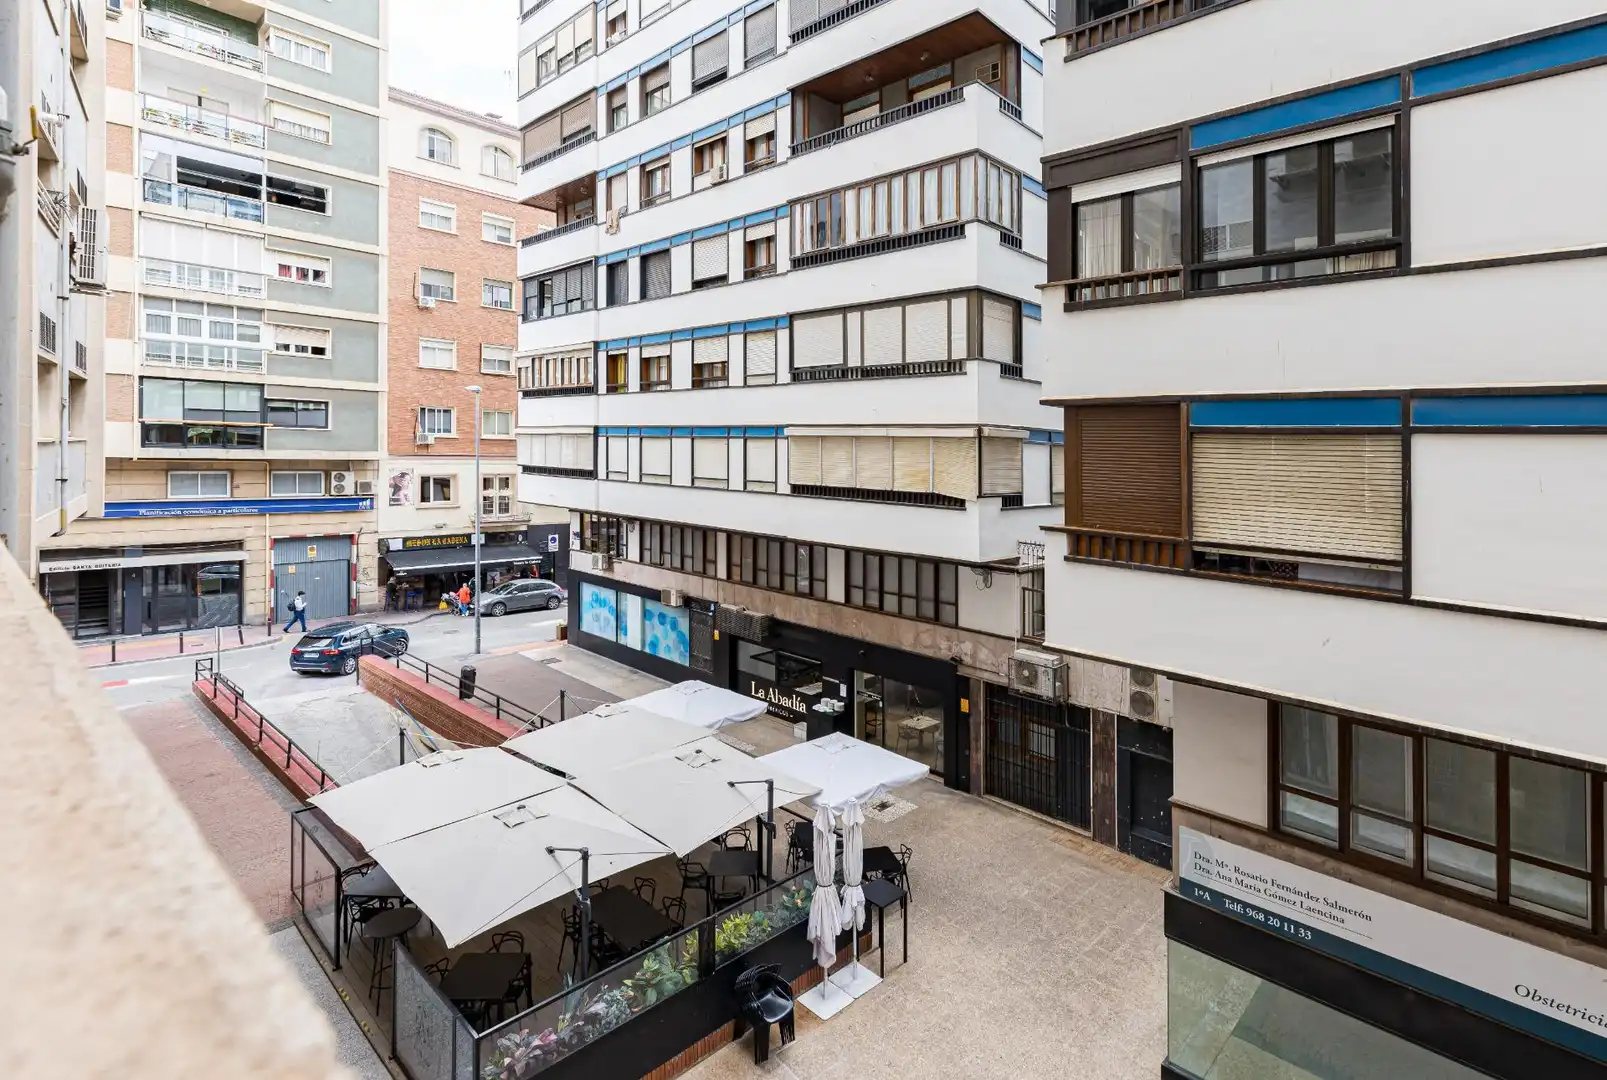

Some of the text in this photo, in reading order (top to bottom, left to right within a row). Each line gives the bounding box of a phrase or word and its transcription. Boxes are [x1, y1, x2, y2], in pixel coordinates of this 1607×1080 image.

[432, 537, 442, 546] LA
[442, 536, 468, 545] CADENA
[751, 681, 807, 714] La Abadía
[1194, 851, 1213, 865] Dra.
[1233, 865, 1268, 885] Rosario
[1271, 878, 1320, 904] Fernández
[1322, 897, 1372, 922] Salmerón
[1194, 862, 1345, 924] Dra. Ana María Gómez Laencina
[1246, 907, 1264, 922] 968
[1267, 915, 1280, 928] 20
[1283, 922, 1295, 934] 11
[1298, 928, 1312, 940] 33
